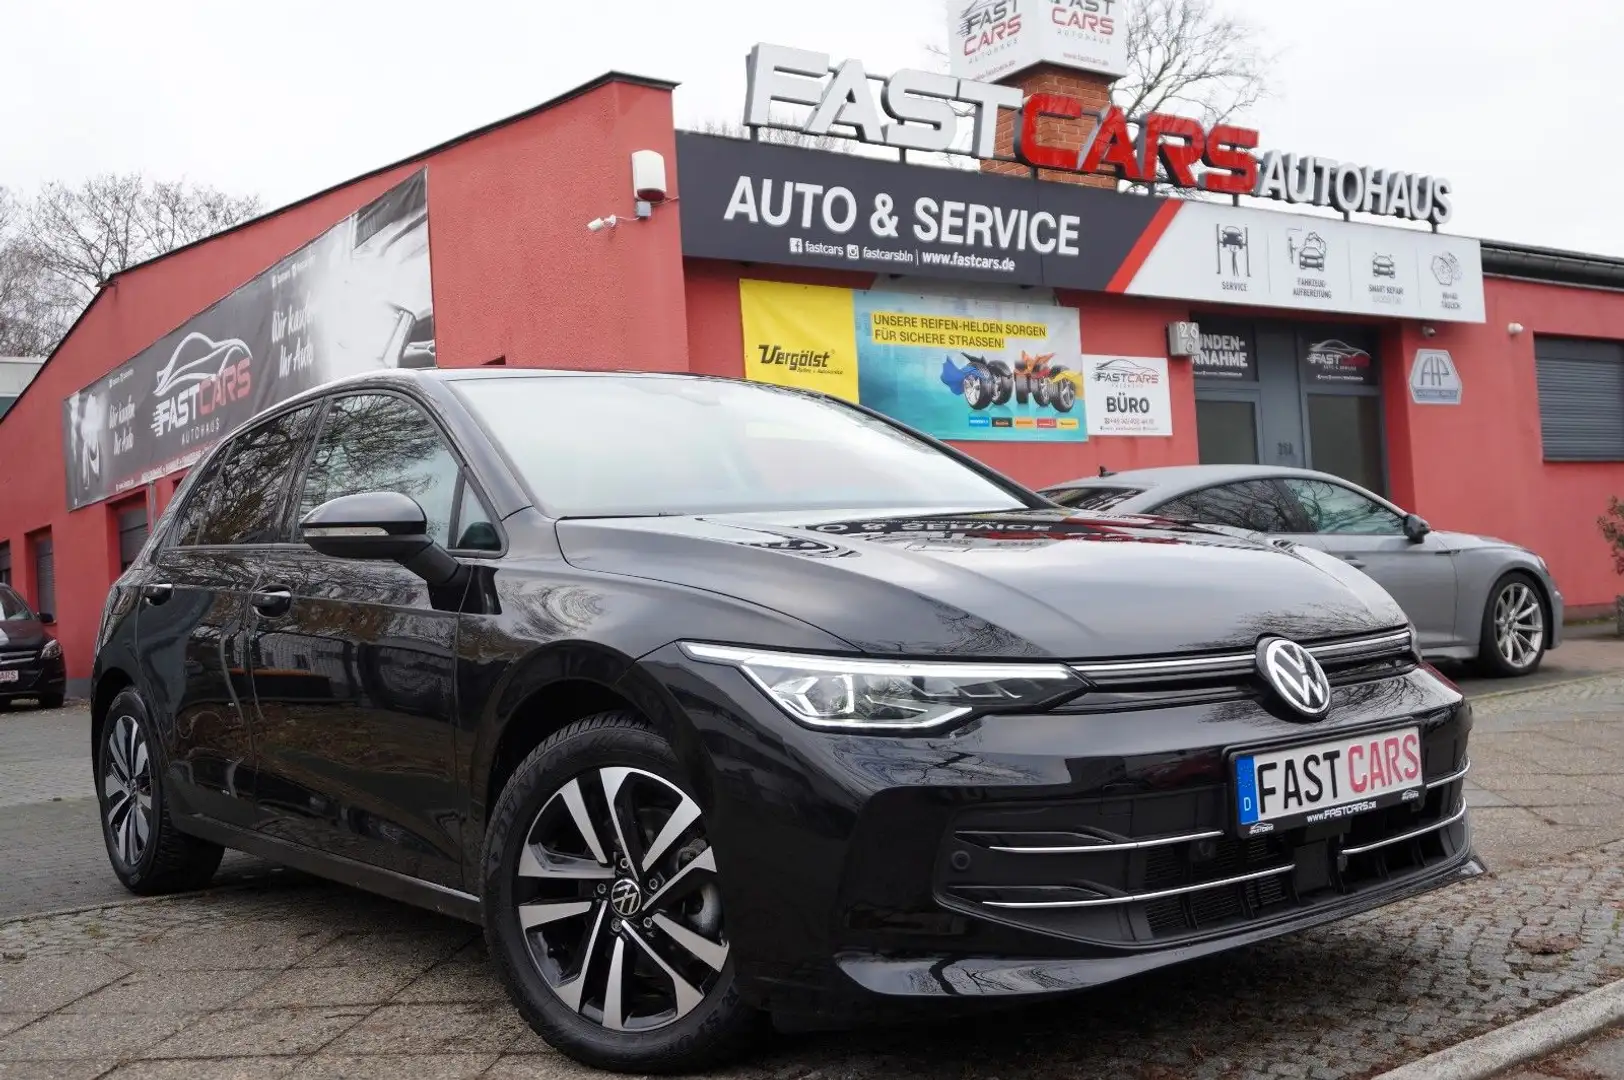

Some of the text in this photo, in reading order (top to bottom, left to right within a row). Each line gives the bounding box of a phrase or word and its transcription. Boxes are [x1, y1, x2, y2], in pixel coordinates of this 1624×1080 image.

[964, 14, 1022, 57] CARS
[1052, 8, 1115, 36] CARS
[1258, 150, 1454, 225] AUTOHAUS
[723, 175, 1081, 256] AUTO & SERVICE
[805, 240, 1016, 271] fastcars fastcarsbln www.fastcars.de
[1221, 281, 1248, 292] SERVICE
[873, 314, 1046, 337] UNSERE REIFEN-HELDEN SORGEN
[874, 327, 1005, 349] FÜR SICHERE STRASSEN!
[758, 344, 830, 371] Vergölst
[1106, 391, 1150, 414] BÜRO
[181, 417, 220, 446] AUTOHAUS
[1243, 733, 1419, 814] D FAST CARS
